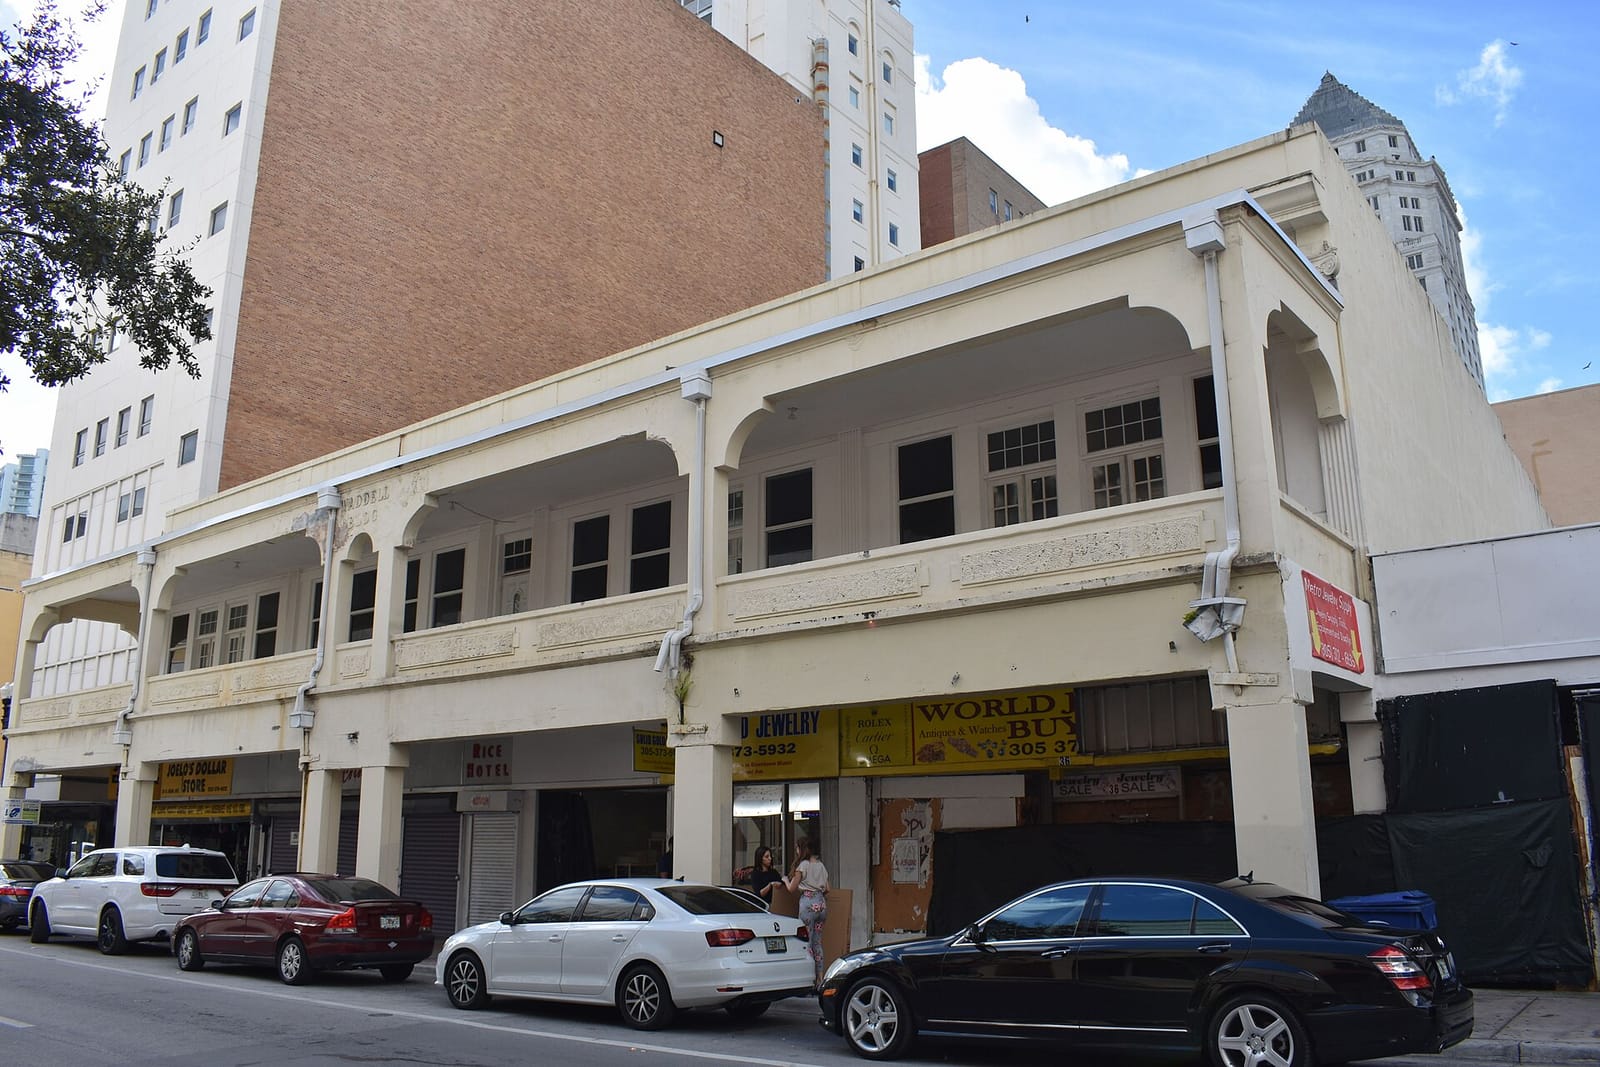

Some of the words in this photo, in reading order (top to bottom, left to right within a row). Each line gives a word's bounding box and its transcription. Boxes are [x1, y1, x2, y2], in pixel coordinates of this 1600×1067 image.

[1304, 578, 1321, 597] Metro
[917, 694, 1056, 722] WORLD
[756, 710, 820, 737] JEWELRY
[857, 718, 892, 729] ROLEX
[855, 730, 893, 744] Cartier
[919, 728, 957, 740] Antiques
[958, 727, 966, 736] &
[968, 724, 1006, 734] Watches
[472, 743, 503, 759] RICE
[732, 743, 796, 757] 73-5932
[1009, 741, 1046, 755] 305
[195, 760, 227, 775] DOLLAR
[1059, 756, 1071, 766] 36
[466, 763, 509, 778] HOTEL
[1117, 772, 1165, 784] Jewelry
[182, 779, 206, 793] STORE
[1059, 785, 1092, 795] SALE
[1121, 782, 1156, 793] SALE
